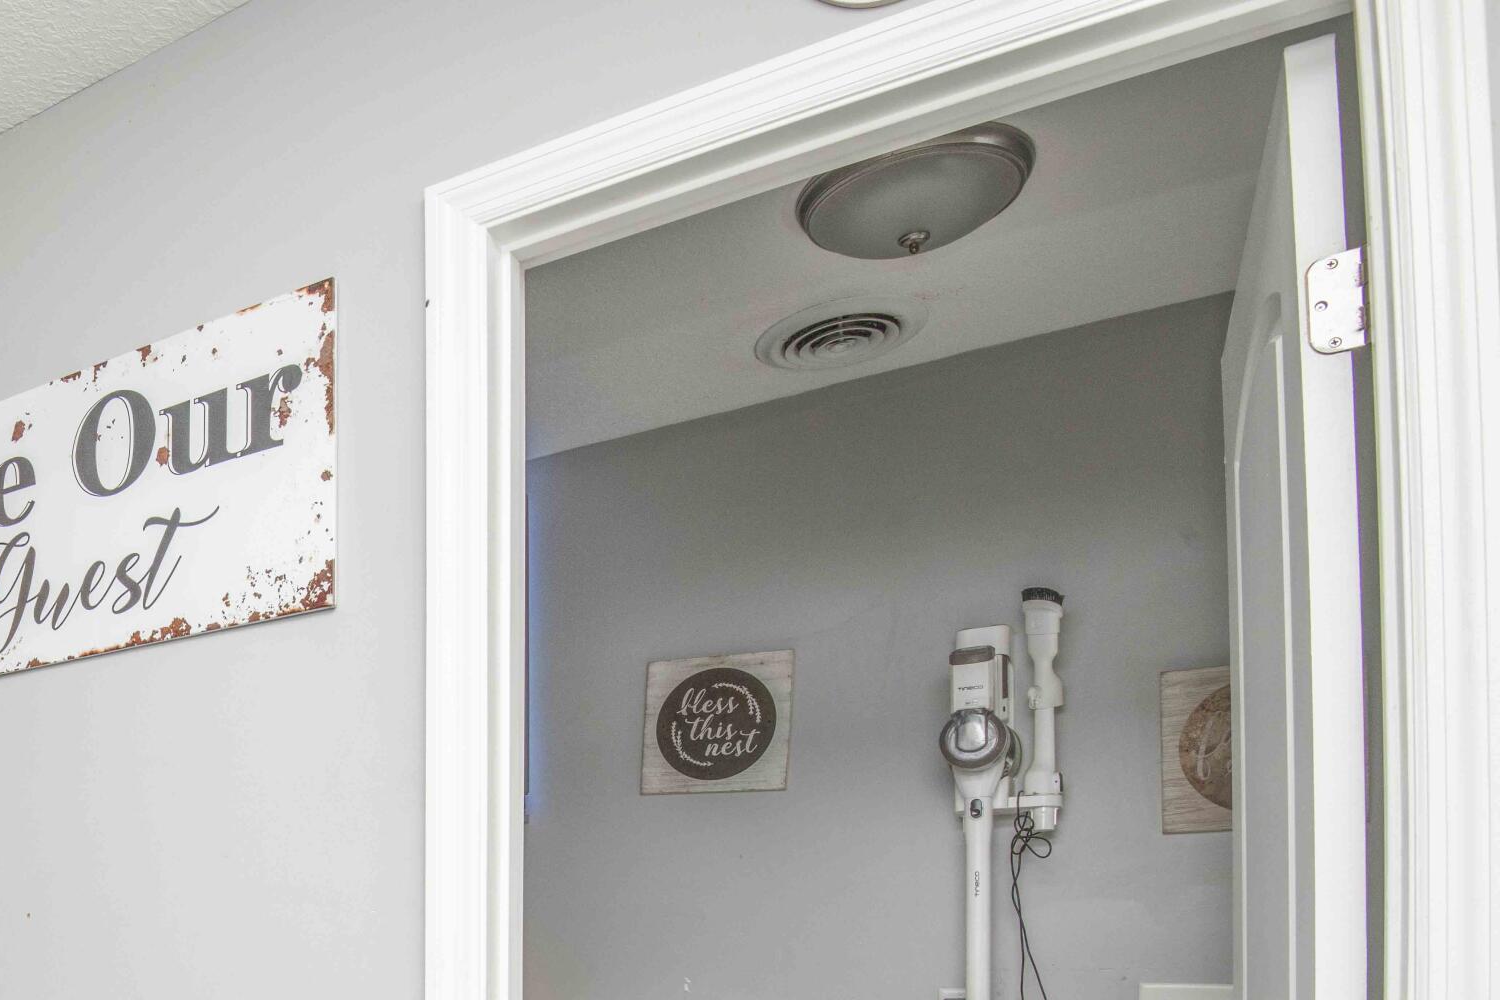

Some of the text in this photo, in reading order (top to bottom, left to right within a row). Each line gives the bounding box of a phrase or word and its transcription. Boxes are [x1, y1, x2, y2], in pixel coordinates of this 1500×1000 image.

[72, 363, 303, 497] Our
[676, 687, 740, 716] bless
[684, 713, 738, 741] this
[704, 728, 761, 757] nest
